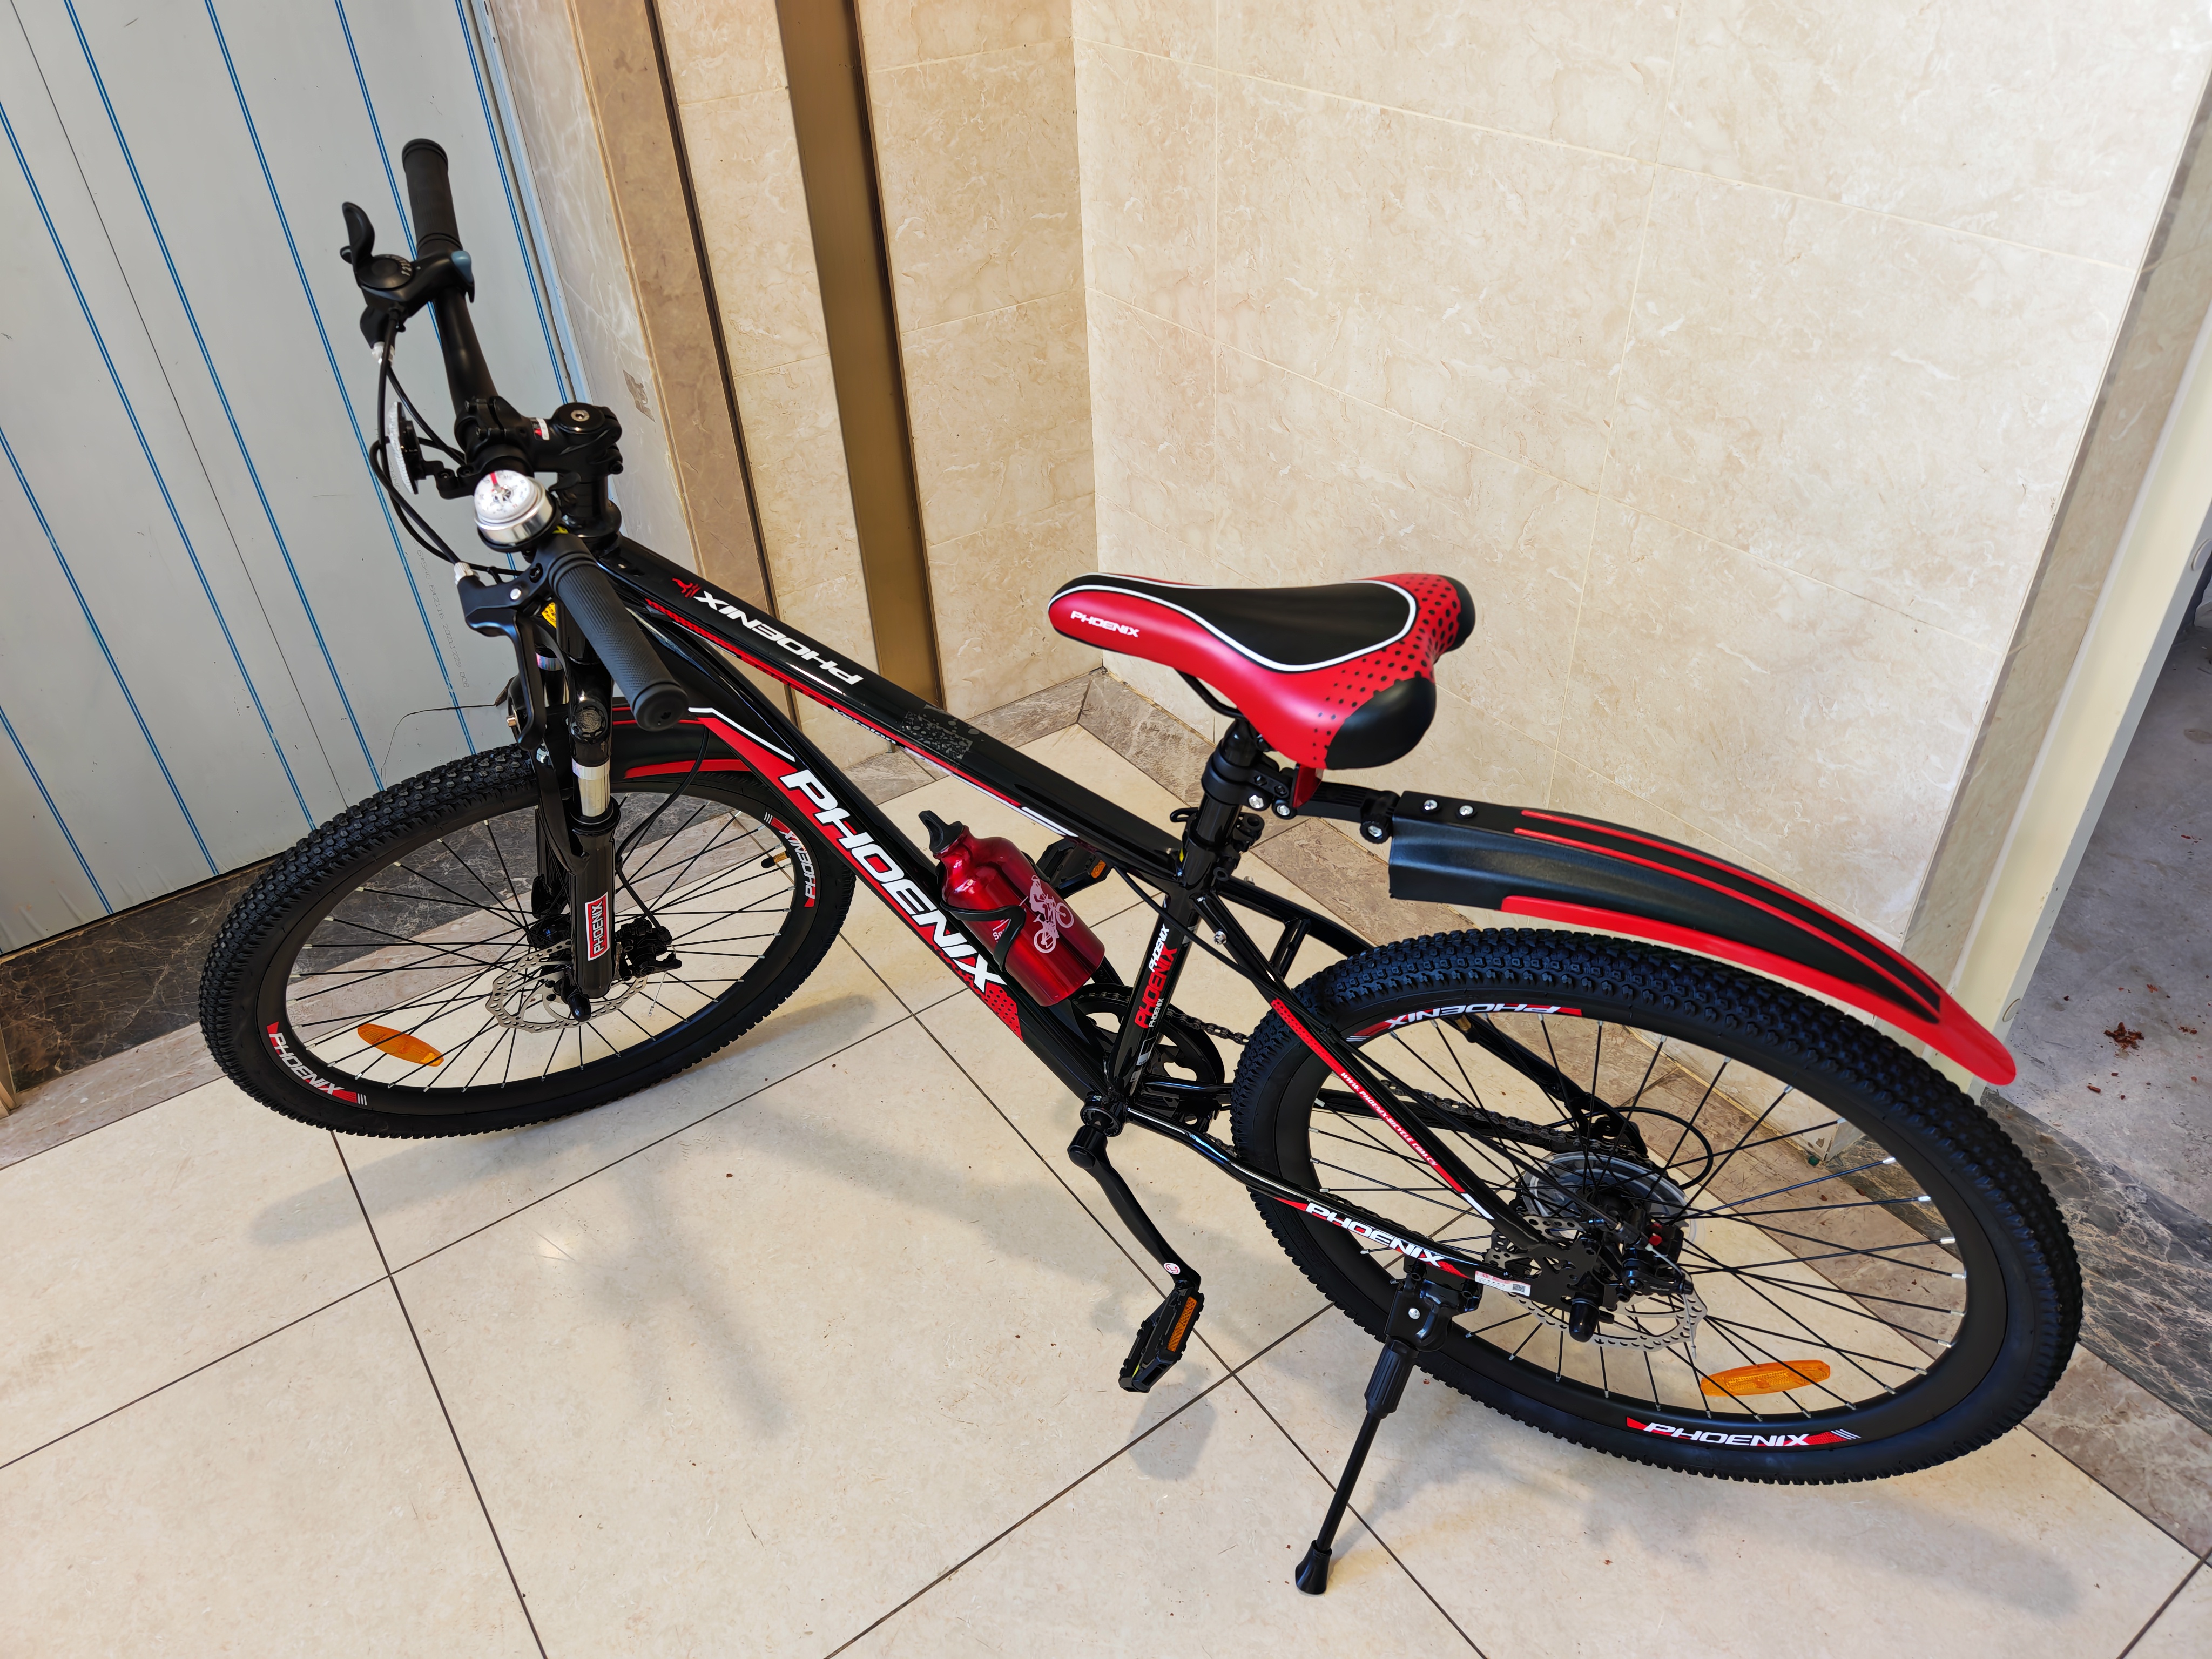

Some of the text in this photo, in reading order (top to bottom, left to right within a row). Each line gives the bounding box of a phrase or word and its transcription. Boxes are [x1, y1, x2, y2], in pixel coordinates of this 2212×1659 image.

[694, 590, 864, 685] PHOENIX
[1070, 610, 1140, 638] PHOENIX
[778, 830, 816, 900] PHOENIX
[779, 769, 1007, 993] PHOENIX
[591, 901, 604, 954] PHOENIX
[1148, 923, 1170, 973] PHOENIX
[1134, 944, 1177, 1029] PHOENIX
[1148, 998, 1164, 1027] PHOENIX
[1385, 1003, 1561, 1029] PHOENIX
[269, 1033, 345, 1095] PHOENIX
[1305, 1202, 1445, 1268] PHOENIX
[1643, 1422, 1810, 1446] PHOENIX
